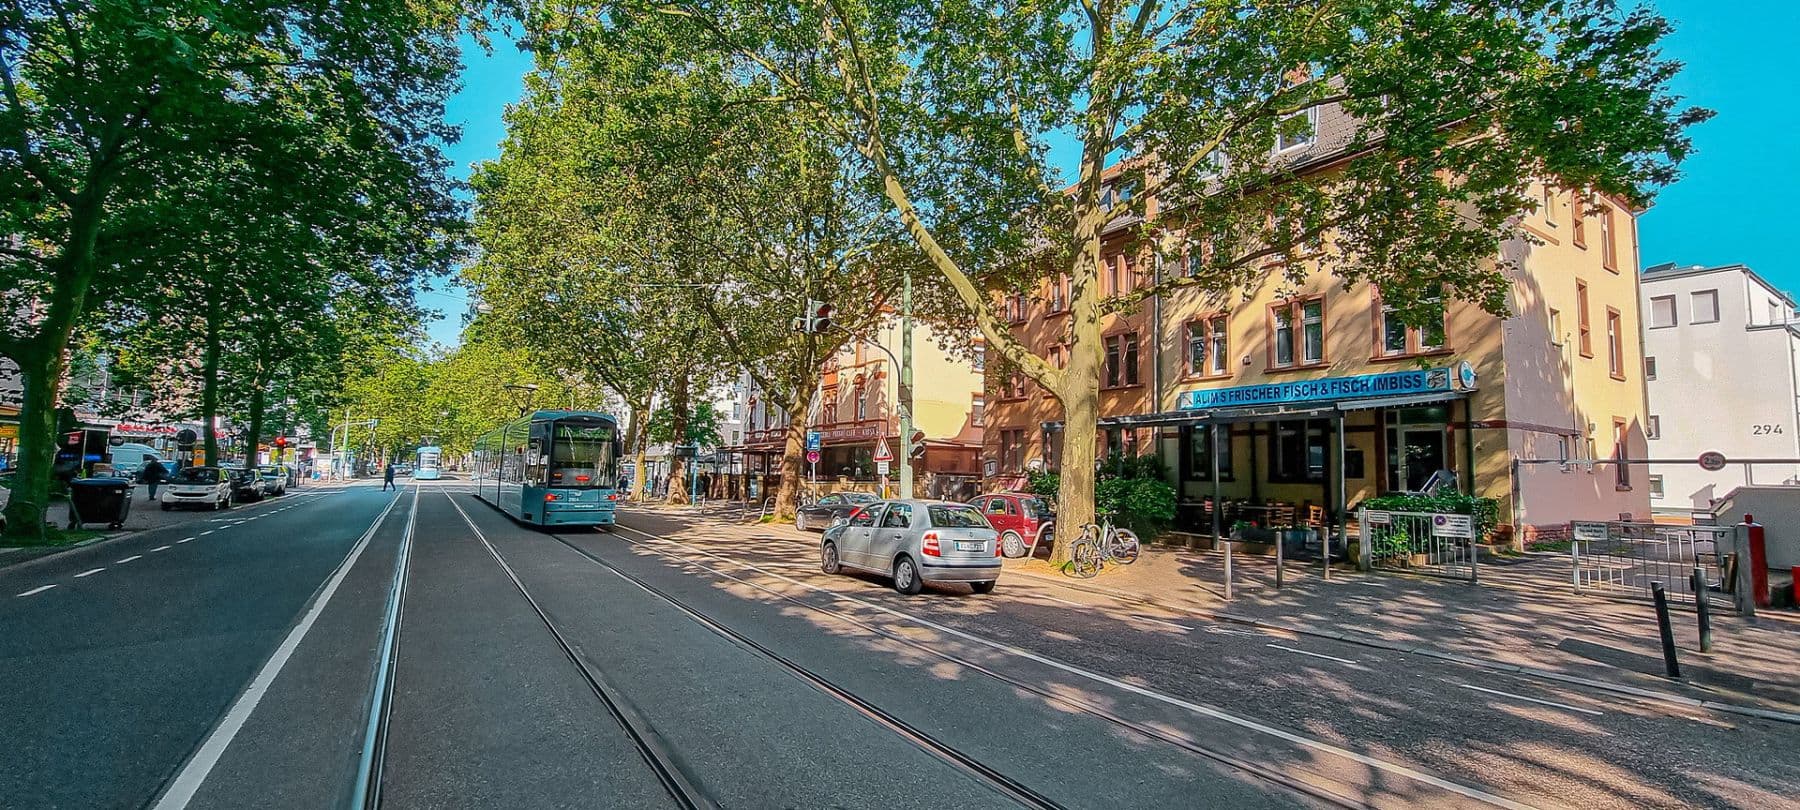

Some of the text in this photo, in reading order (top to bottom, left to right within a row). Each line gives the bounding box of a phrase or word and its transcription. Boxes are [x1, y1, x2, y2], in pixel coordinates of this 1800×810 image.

[1229, 386, 1280, 401] FRISCHER
[1284, 383, 1318, 398] FISCH
[1320, 382, 1328, 395] &
[1331, 379, 1369, 394] FISCH
[1373, 374, 1421, 391] IMBISS
[1753, 424, 1783, 435] 294
